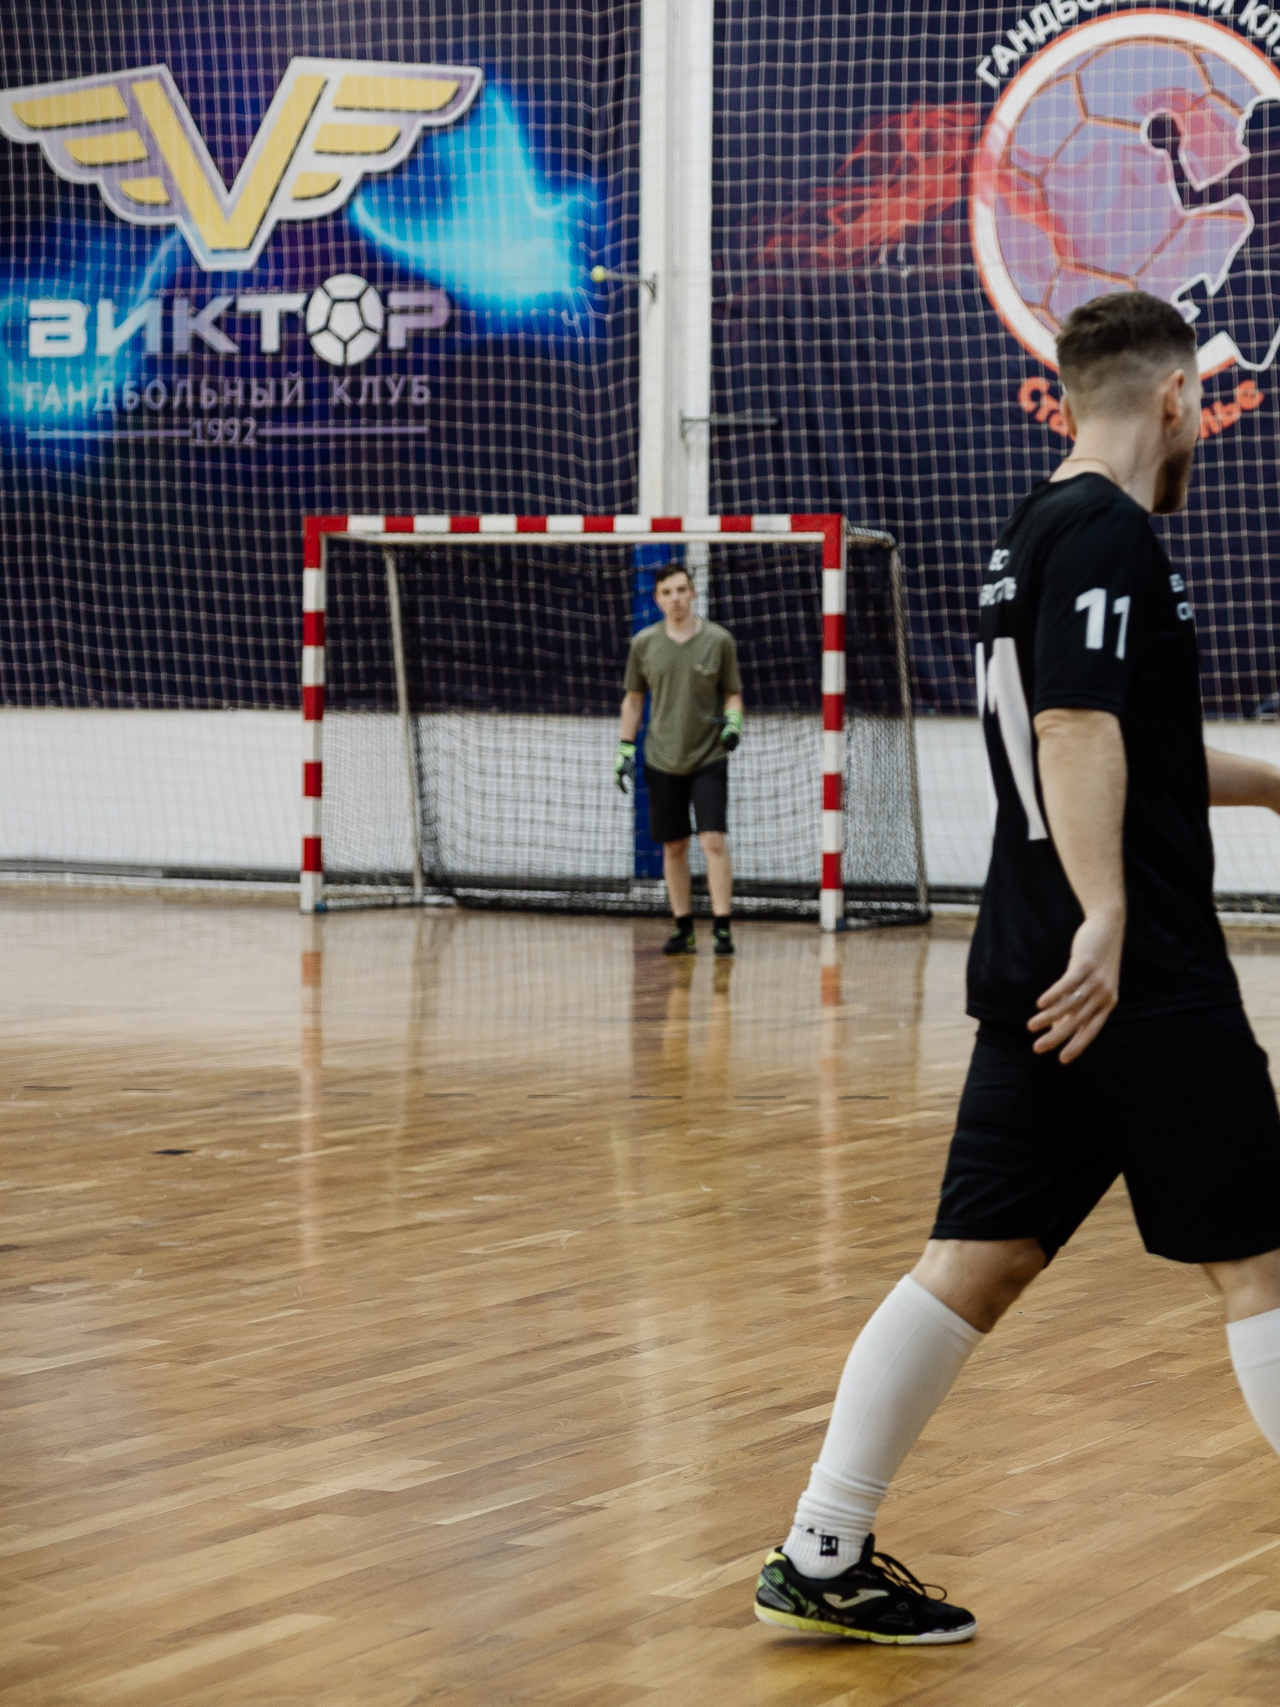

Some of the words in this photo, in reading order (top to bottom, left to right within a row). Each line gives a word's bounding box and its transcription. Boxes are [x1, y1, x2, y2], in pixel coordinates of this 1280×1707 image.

[24, 371, 306, 415] ГАНДБОЛЬНЫЙ
[332, 374, 431, 406] КЛУБ
[189, 416, 258, 446] 1992
[1075, 587, 1131, 660] 11
